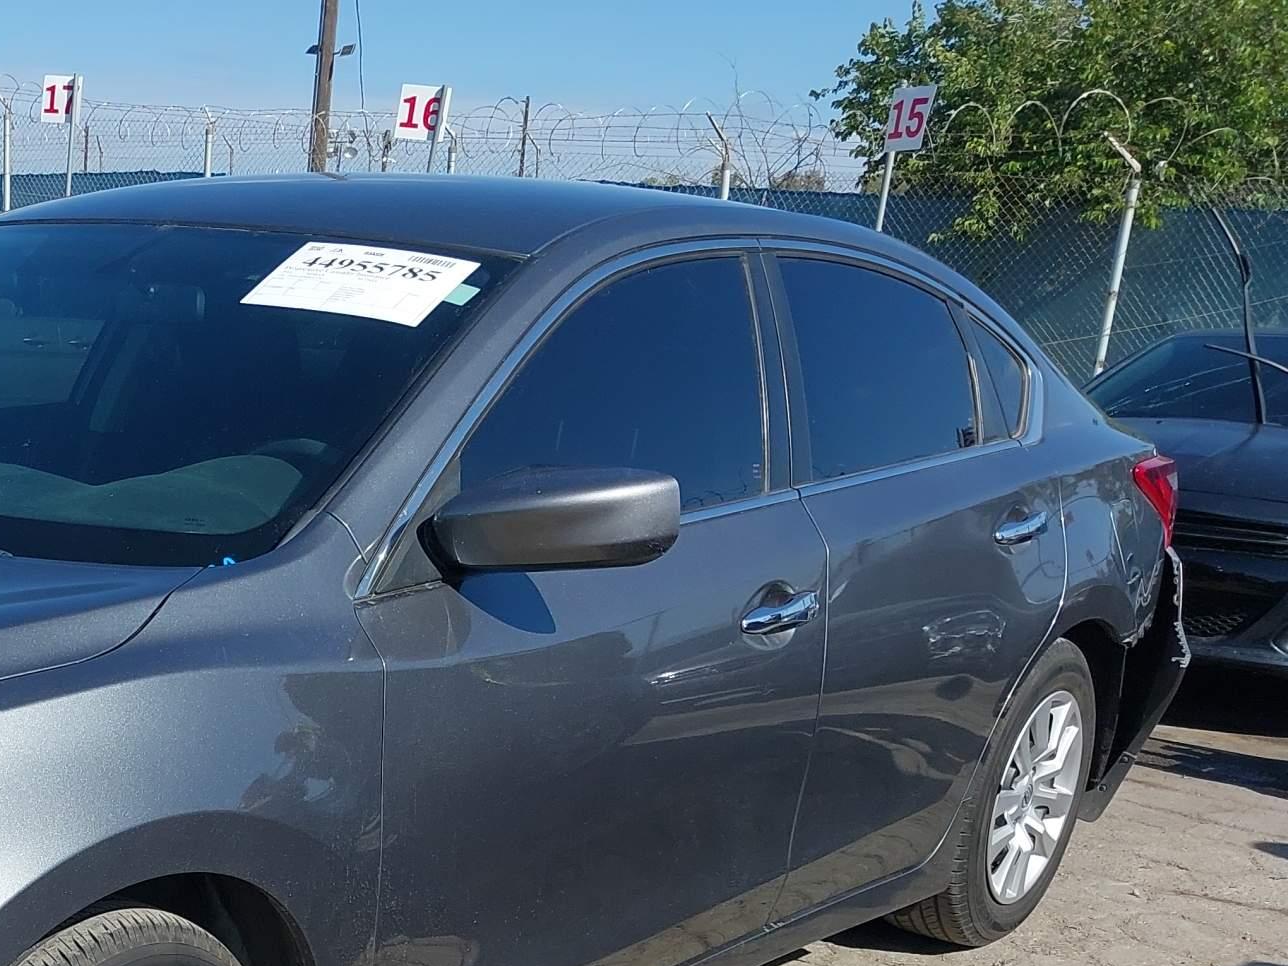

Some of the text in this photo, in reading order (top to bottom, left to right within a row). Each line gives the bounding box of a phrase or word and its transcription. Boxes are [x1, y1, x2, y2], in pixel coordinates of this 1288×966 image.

[43, 84, 76, 115] 17
[399, 96, 441, 132] 16
[887, 97, 929, 140] 15
[302, 256, 442, 281] 44955785
